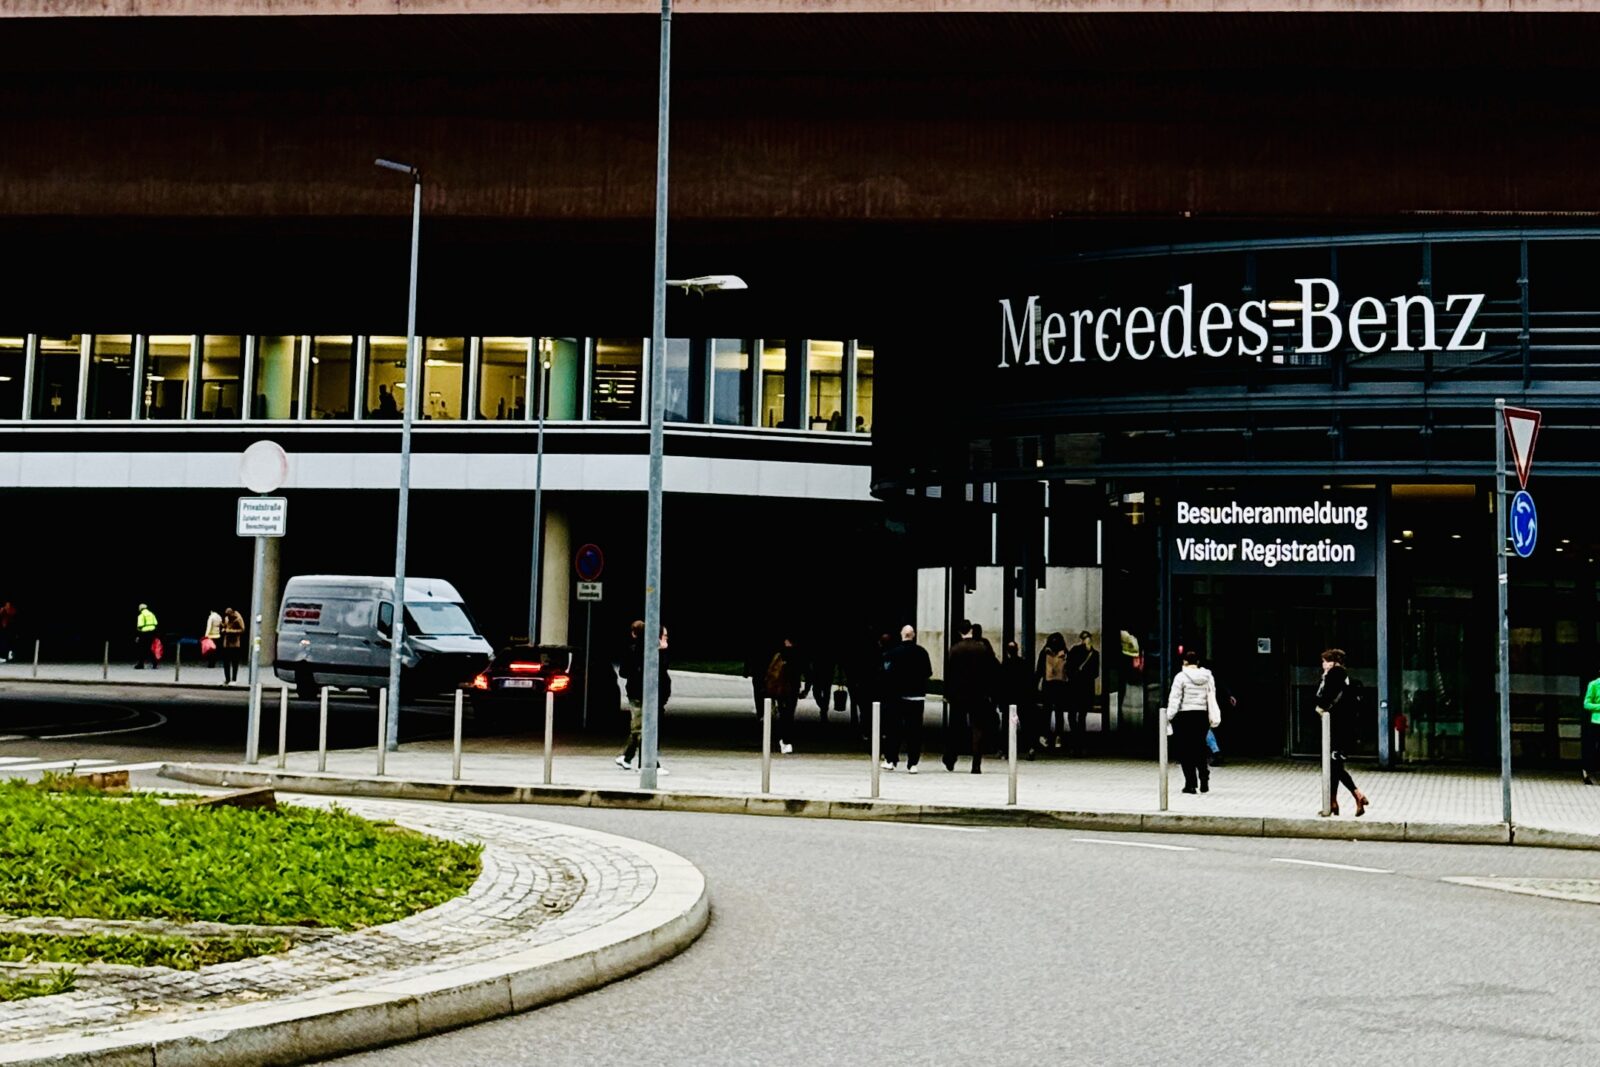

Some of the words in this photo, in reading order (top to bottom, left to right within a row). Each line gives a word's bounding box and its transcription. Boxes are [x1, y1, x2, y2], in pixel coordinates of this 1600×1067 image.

[998, 278, 1487, 368] Mercedes-Benz
[243, 502, 281, 511] Privatstraße
[1177, 500, 1369, 530] Besucheranmeldung
[1176, 537, 1237, 562] Visitor
[1242, 537, 1355, 567] Registration
